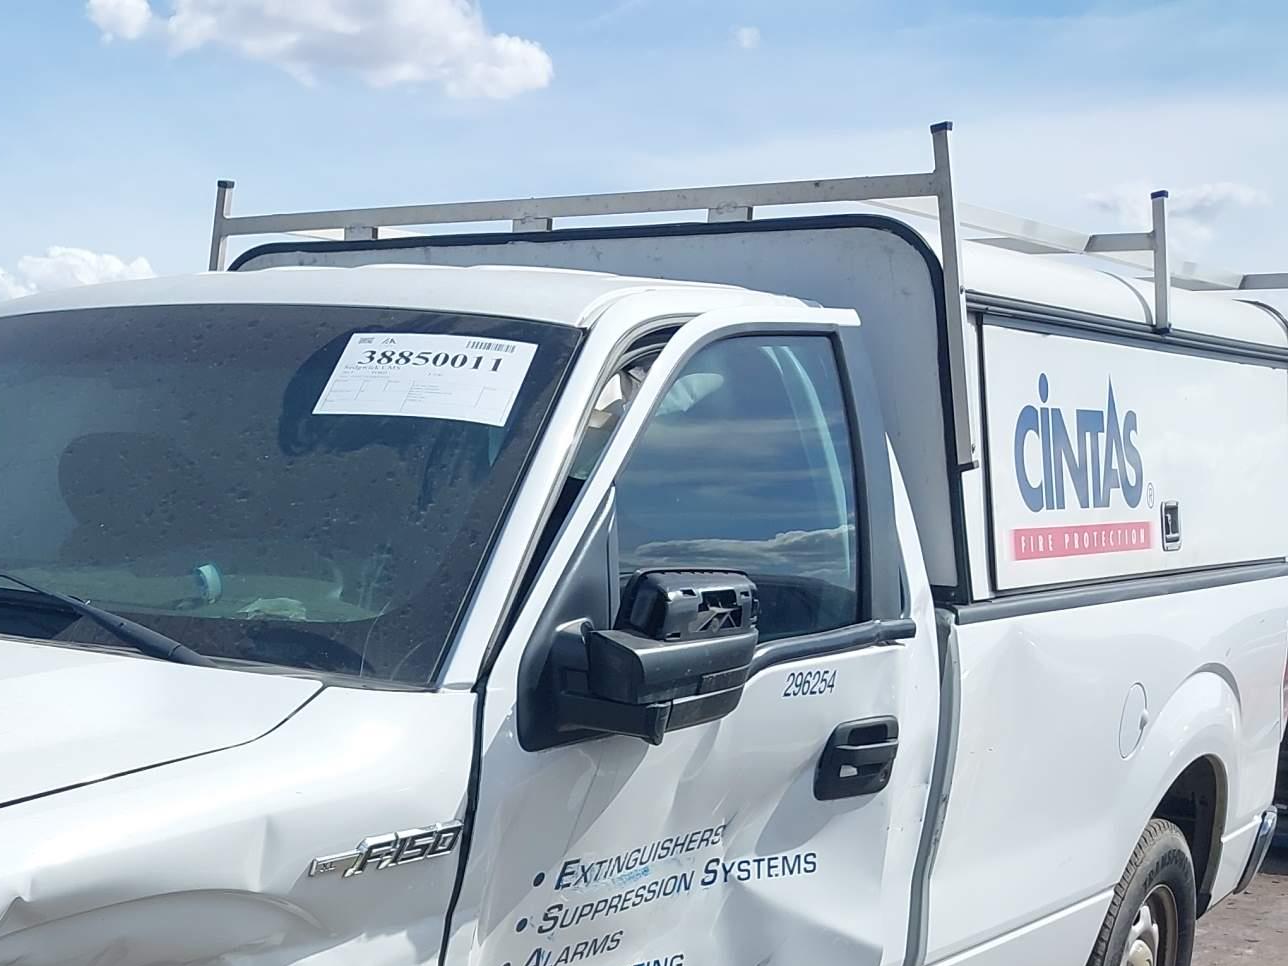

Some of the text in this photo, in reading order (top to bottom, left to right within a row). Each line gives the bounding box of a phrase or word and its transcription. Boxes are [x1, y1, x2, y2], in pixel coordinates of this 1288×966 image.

[357, 350, 503, 372] 38850011
[1021, 528, 1145, 553] FIRE PROTECTION
[783, 670, 837, 697] 296254
[554, 824, 726, 890] EXTINGUISHERS
[537, 852, 817, 934] SUPPRESSION SYSTEMS
